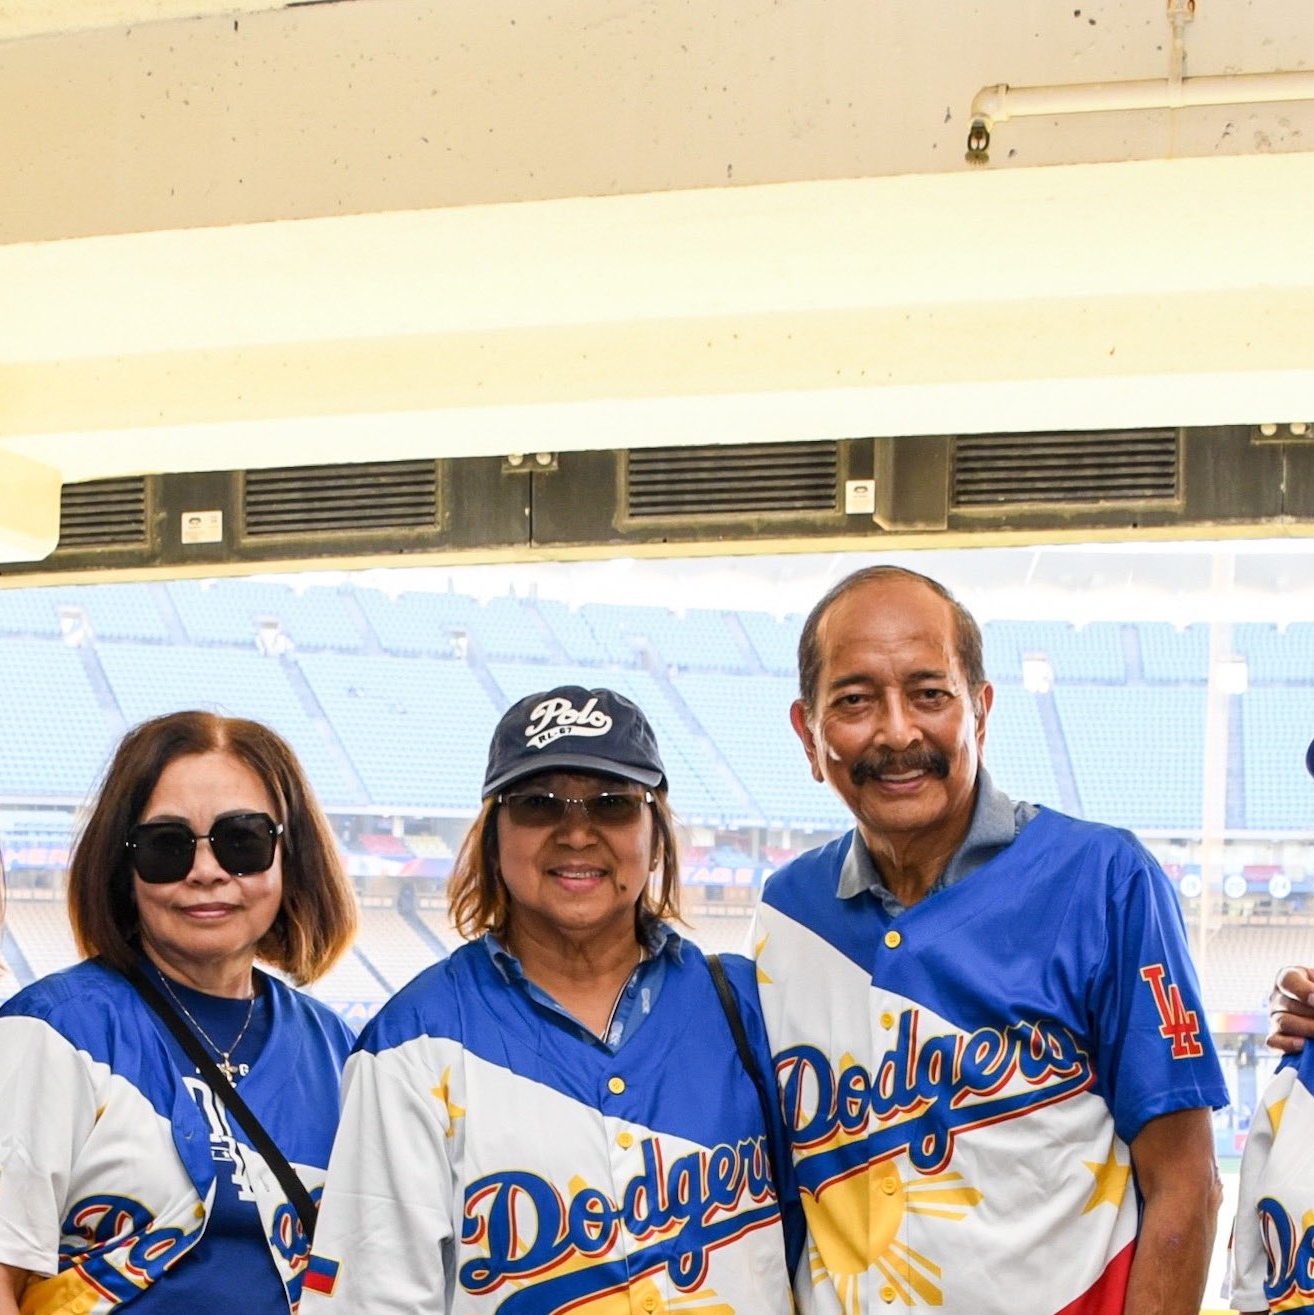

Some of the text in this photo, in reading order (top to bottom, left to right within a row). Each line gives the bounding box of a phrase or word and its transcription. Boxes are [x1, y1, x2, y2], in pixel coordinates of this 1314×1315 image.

[525, 697, 613, 737] Polo
[538, 726, 573, 744] RL-67
[1140, 962, 1205, 1060] LA
[773, 1007, 1095, 1174] Dodgers
